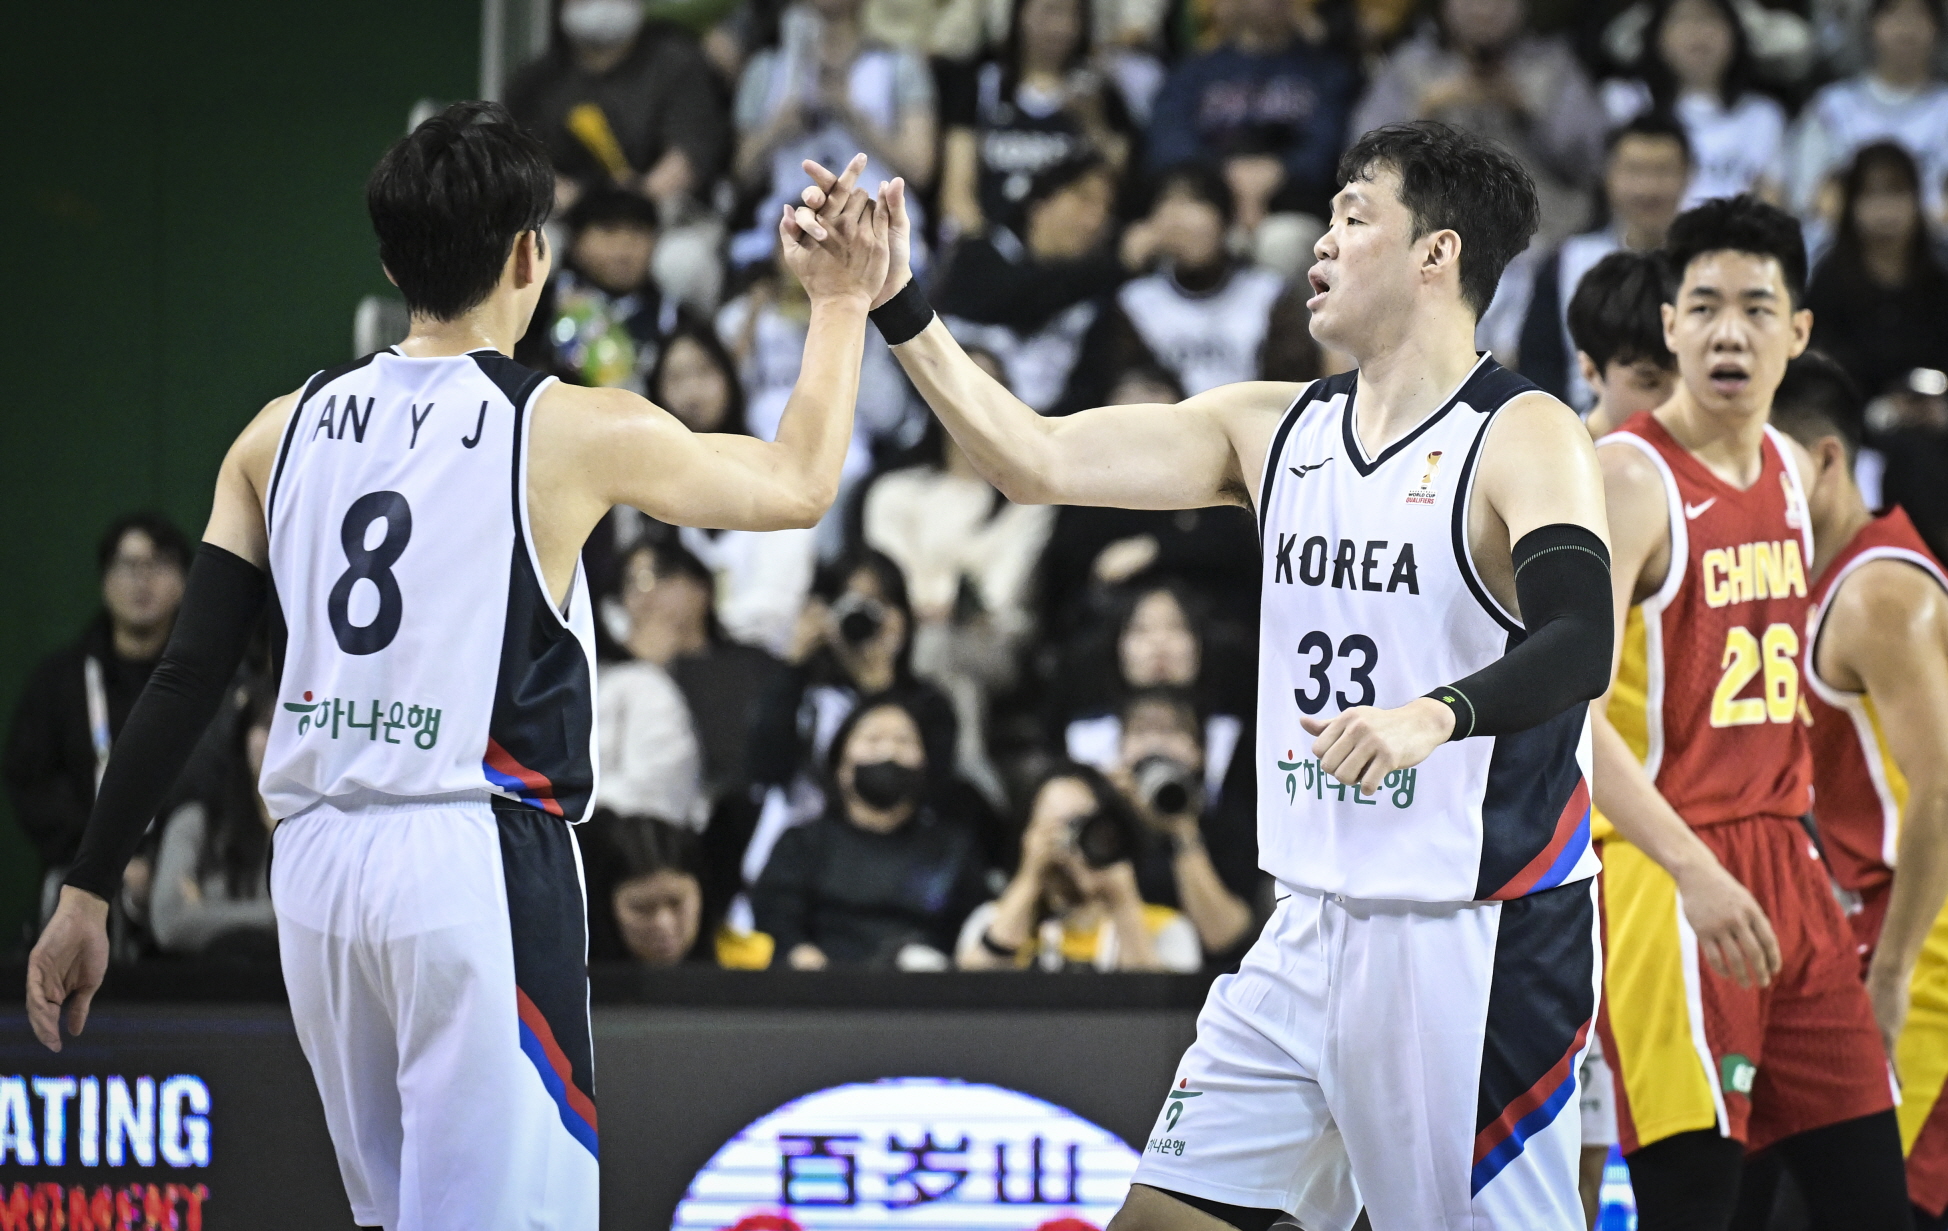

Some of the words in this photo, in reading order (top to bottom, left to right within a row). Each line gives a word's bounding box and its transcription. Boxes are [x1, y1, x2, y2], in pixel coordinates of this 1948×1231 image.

[312, 394, 376, 444] AN
[408, 402, 435, 450] Y
[461, 400, 489, 449] J
[328, 490, 412, 656] 8
[1275, 532, 1420, 596] KOREA
[1702, 539, 1808, 609] CHINA
[1294, 630, 1379, 716] 33
[1709, 622, 1799, 728] 26
[314, 697, 443, 750] 하나은행
[0, 1074, 212, 1168] ATING
[778, 1132, 1082, 1210] 百岁山
